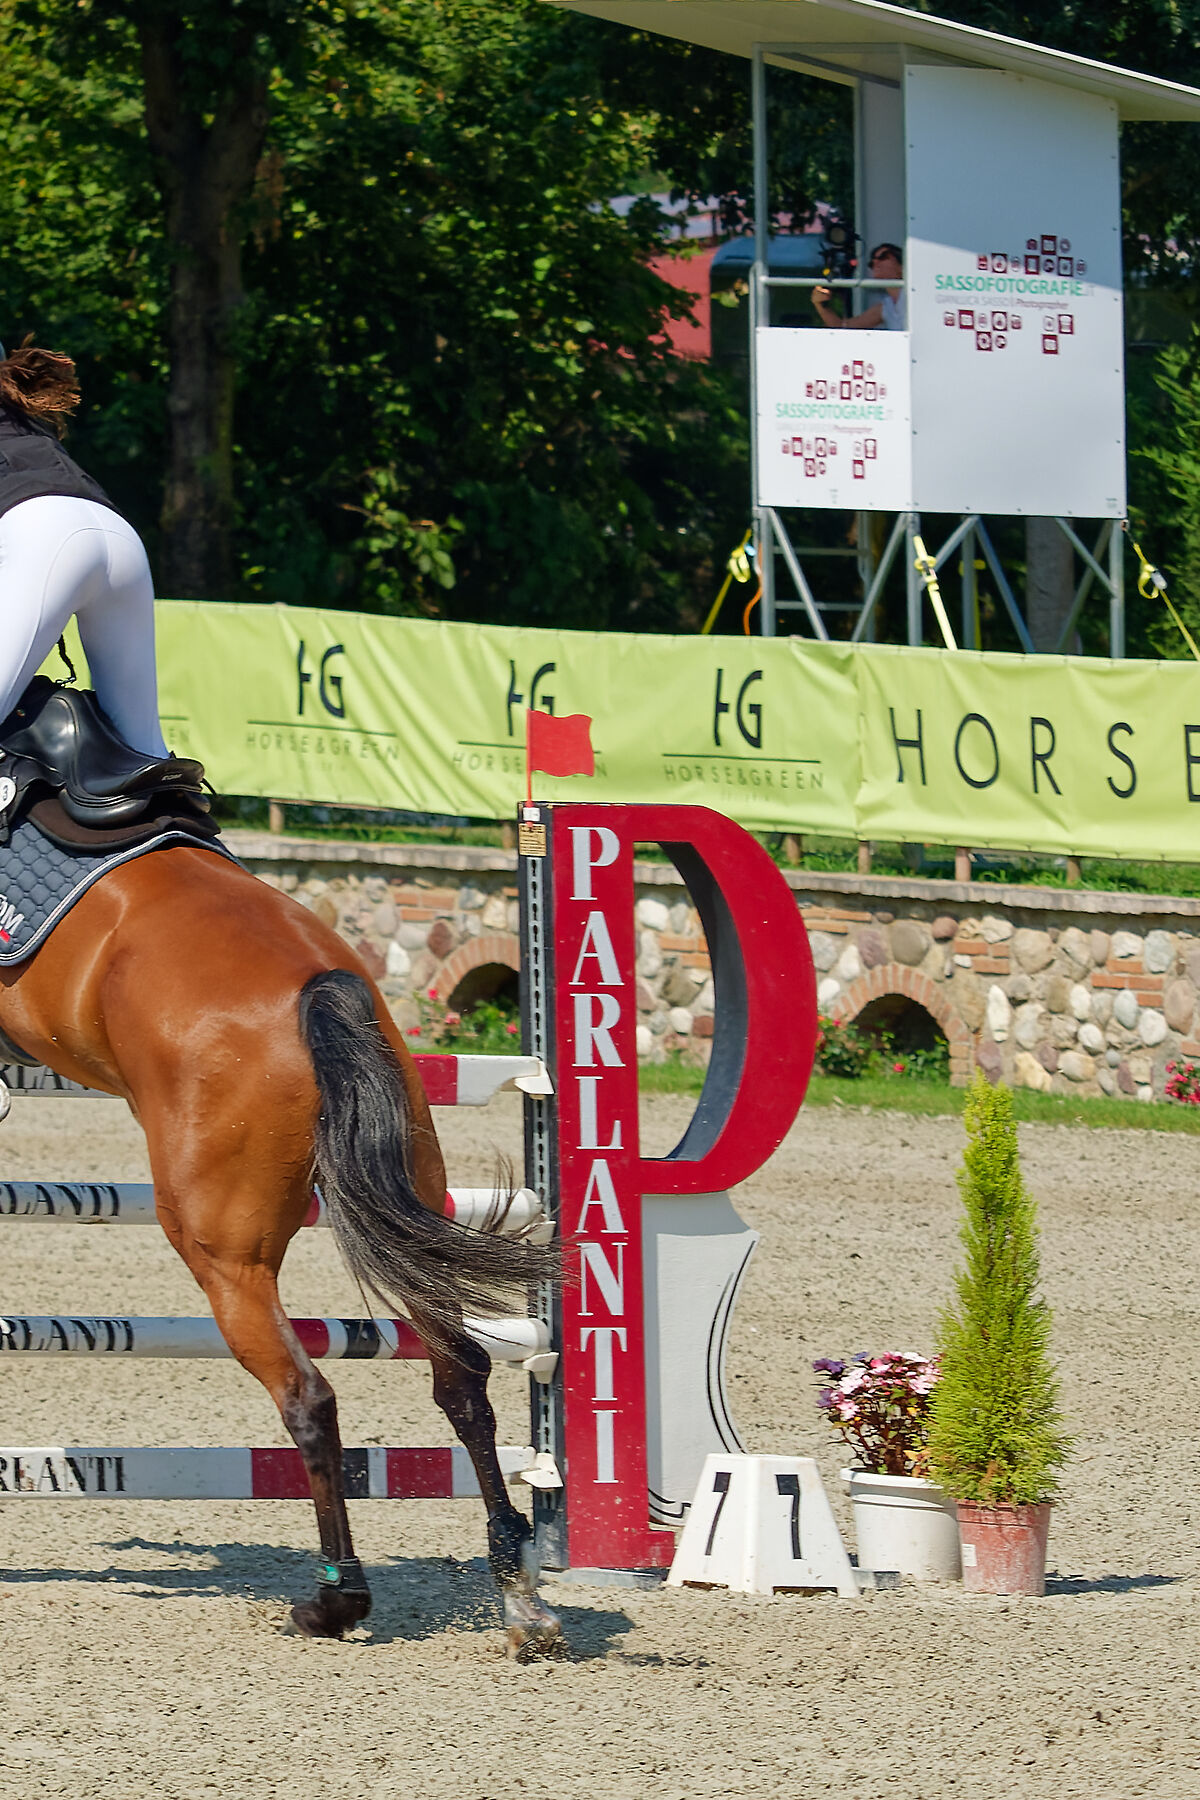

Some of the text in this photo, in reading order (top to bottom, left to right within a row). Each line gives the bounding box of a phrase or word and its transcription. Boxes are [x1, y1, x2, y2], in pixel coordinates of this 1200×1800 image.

[567, 826, 630, 1485] PARLANTI
[704, 1471, 733, 1556] 7
[774, 1473, 804, 1561] 7
